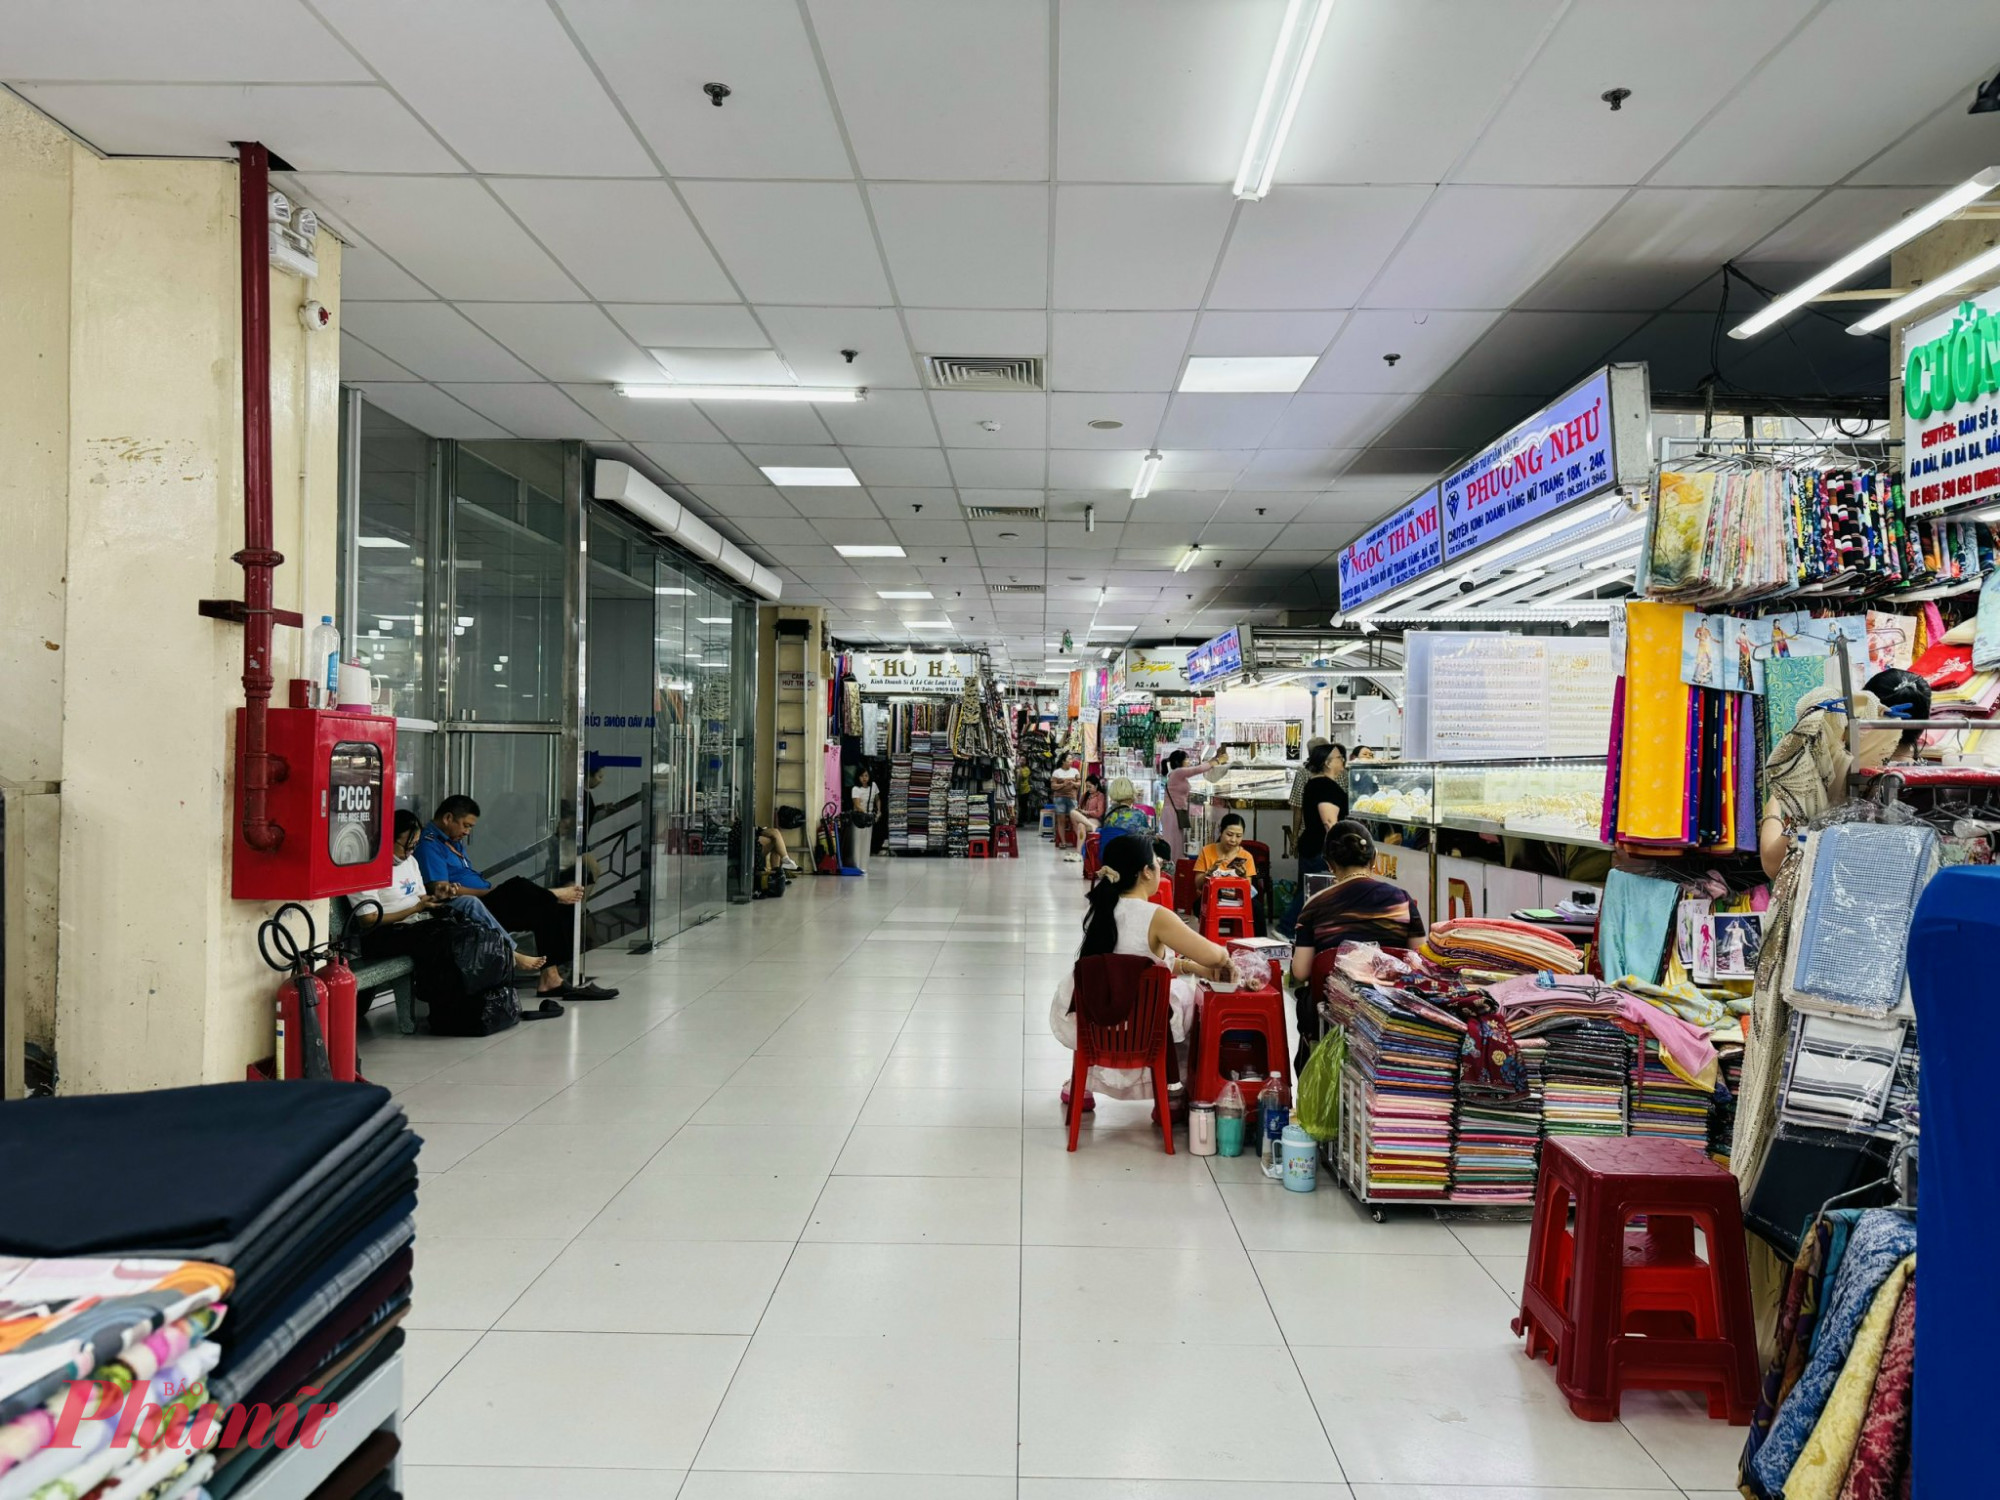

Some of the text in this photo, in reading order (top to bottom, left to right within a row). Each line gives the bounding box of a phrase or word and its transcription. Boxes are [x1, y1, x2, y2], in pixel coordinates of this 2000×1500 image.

[1549, 397, 1601, 464] NHƯ
[1958, 413, 1977, 436] BÁN
[1991, 408, 1998, 426] &
[1941, 449, 1953, 469] ÁO
[1447, 521, 1469, 544] CHUYÊN
[1470, 514, 1485, 536] KINH
[1485, 502, 1506, 524] DOANH
[1507, 491, 1526, 514] VÀNG
[1539, 472, 1565, 497] TRANG
[1589, 449, 1606, 472] 24K
[1352, 539, 1385, 578] NGỌC
[1387, 504, 1438, 556] THANH
[338, 785, 371, 811] PCCC
[338, 812, 348, 823] FIRE
